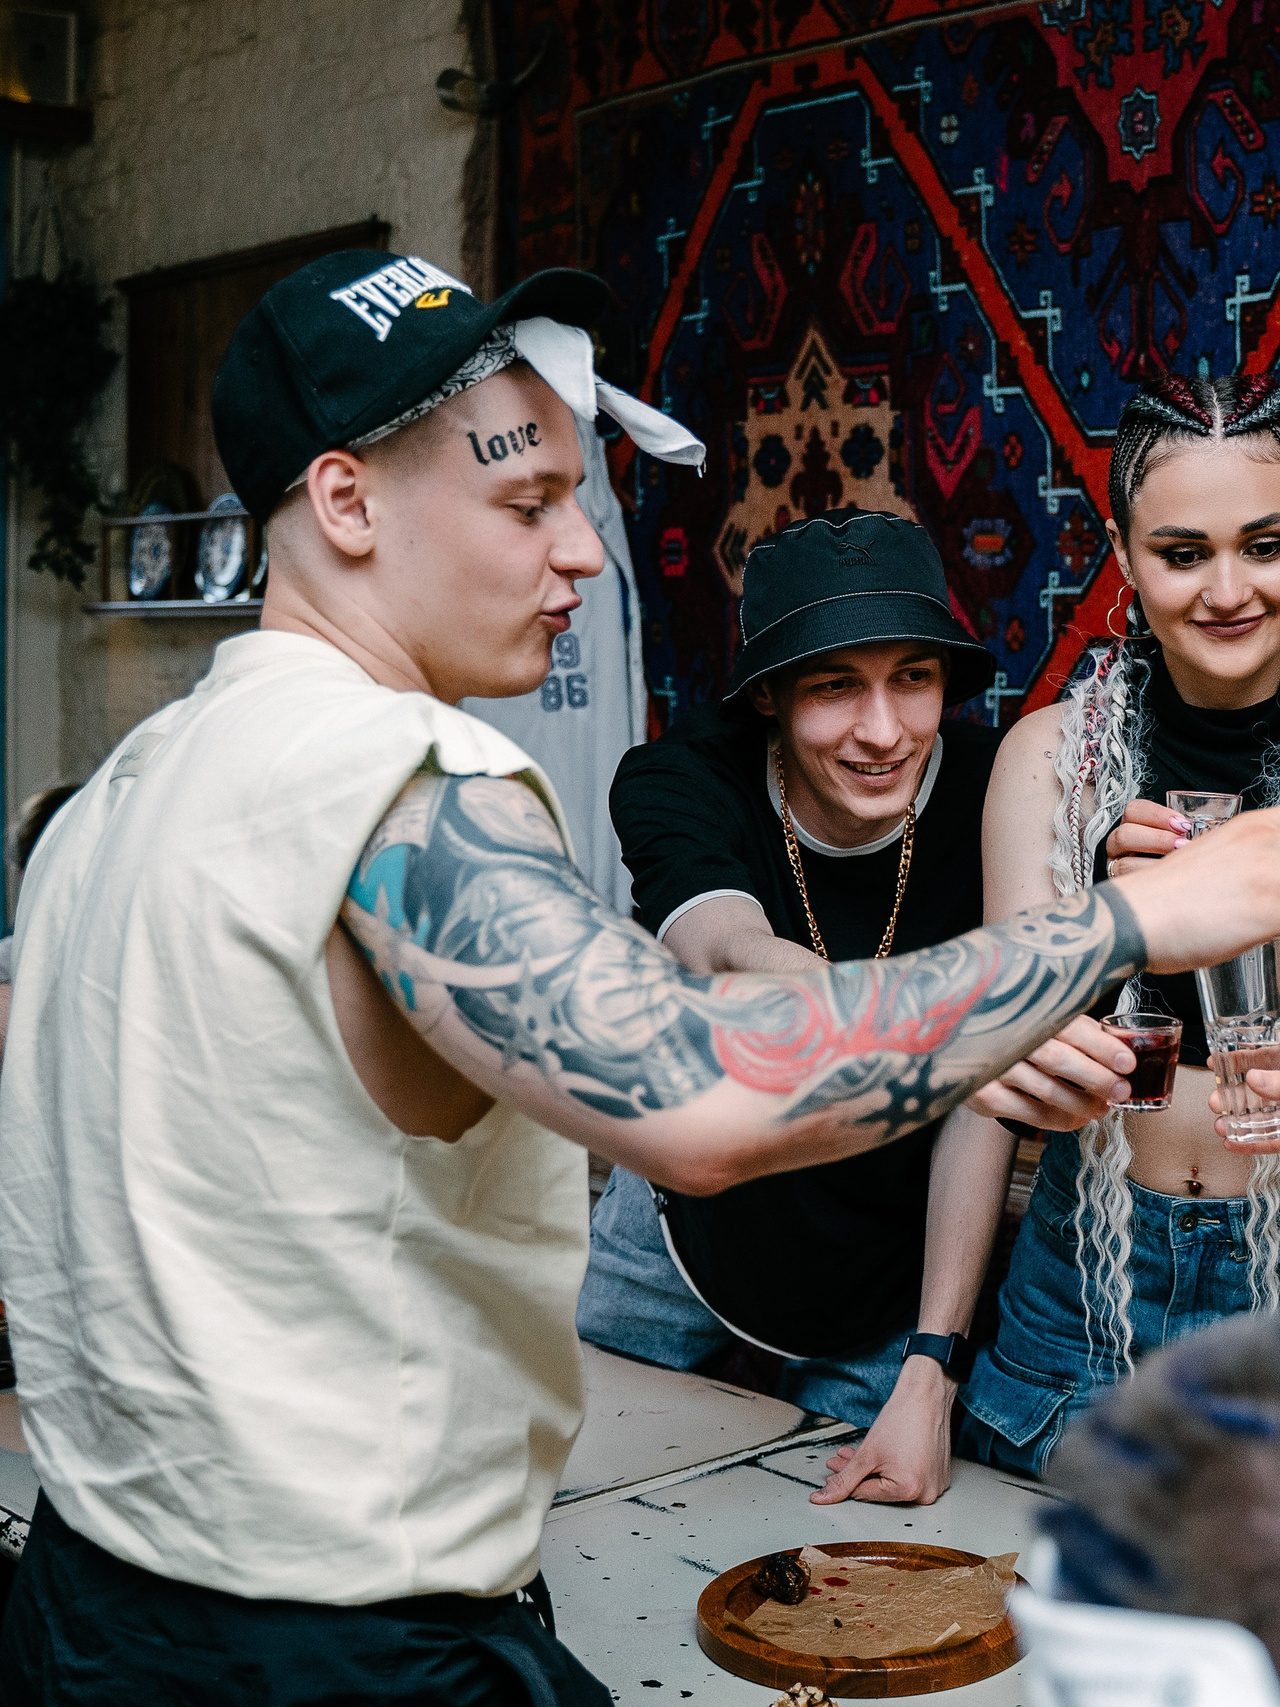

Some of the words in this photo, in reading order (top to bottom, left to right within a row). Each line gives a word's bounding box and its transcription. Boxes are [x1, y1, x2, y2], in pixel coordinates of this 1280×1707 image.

[466, 422, 542, 466] love
[551, 632, 581, 669] 9
[541, 672, 589, 712] 86
